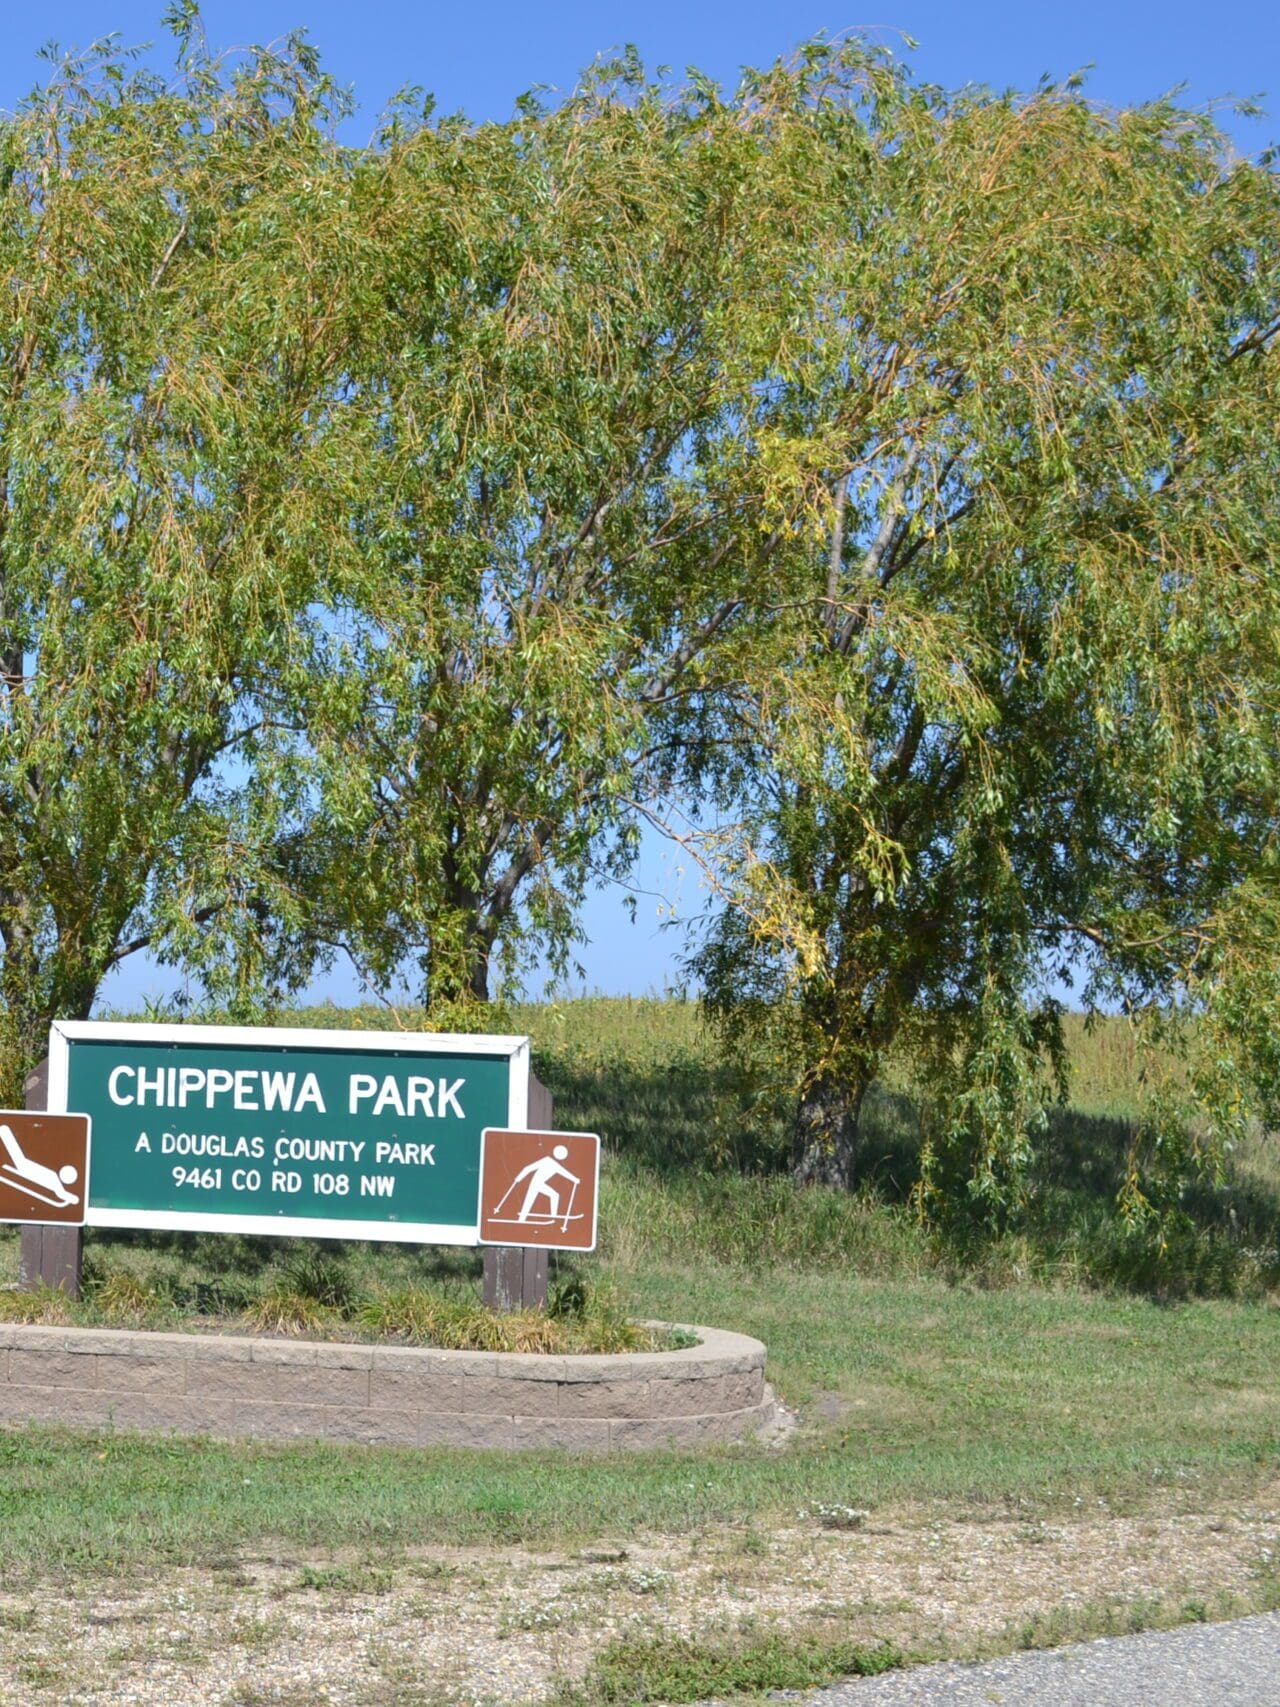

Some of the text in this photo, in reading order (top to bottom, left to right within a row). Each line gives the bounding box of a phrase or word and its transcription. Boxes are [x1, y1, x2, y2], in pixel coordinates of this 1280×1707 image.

[107, 1064, 466, 1119] CHIPPEWA PARK
[134, 1131, 436, 1166] A DOUGLAS COUNTY PARK
[171, 1165, 396, 1198] 9461 CO RD 108 NW
